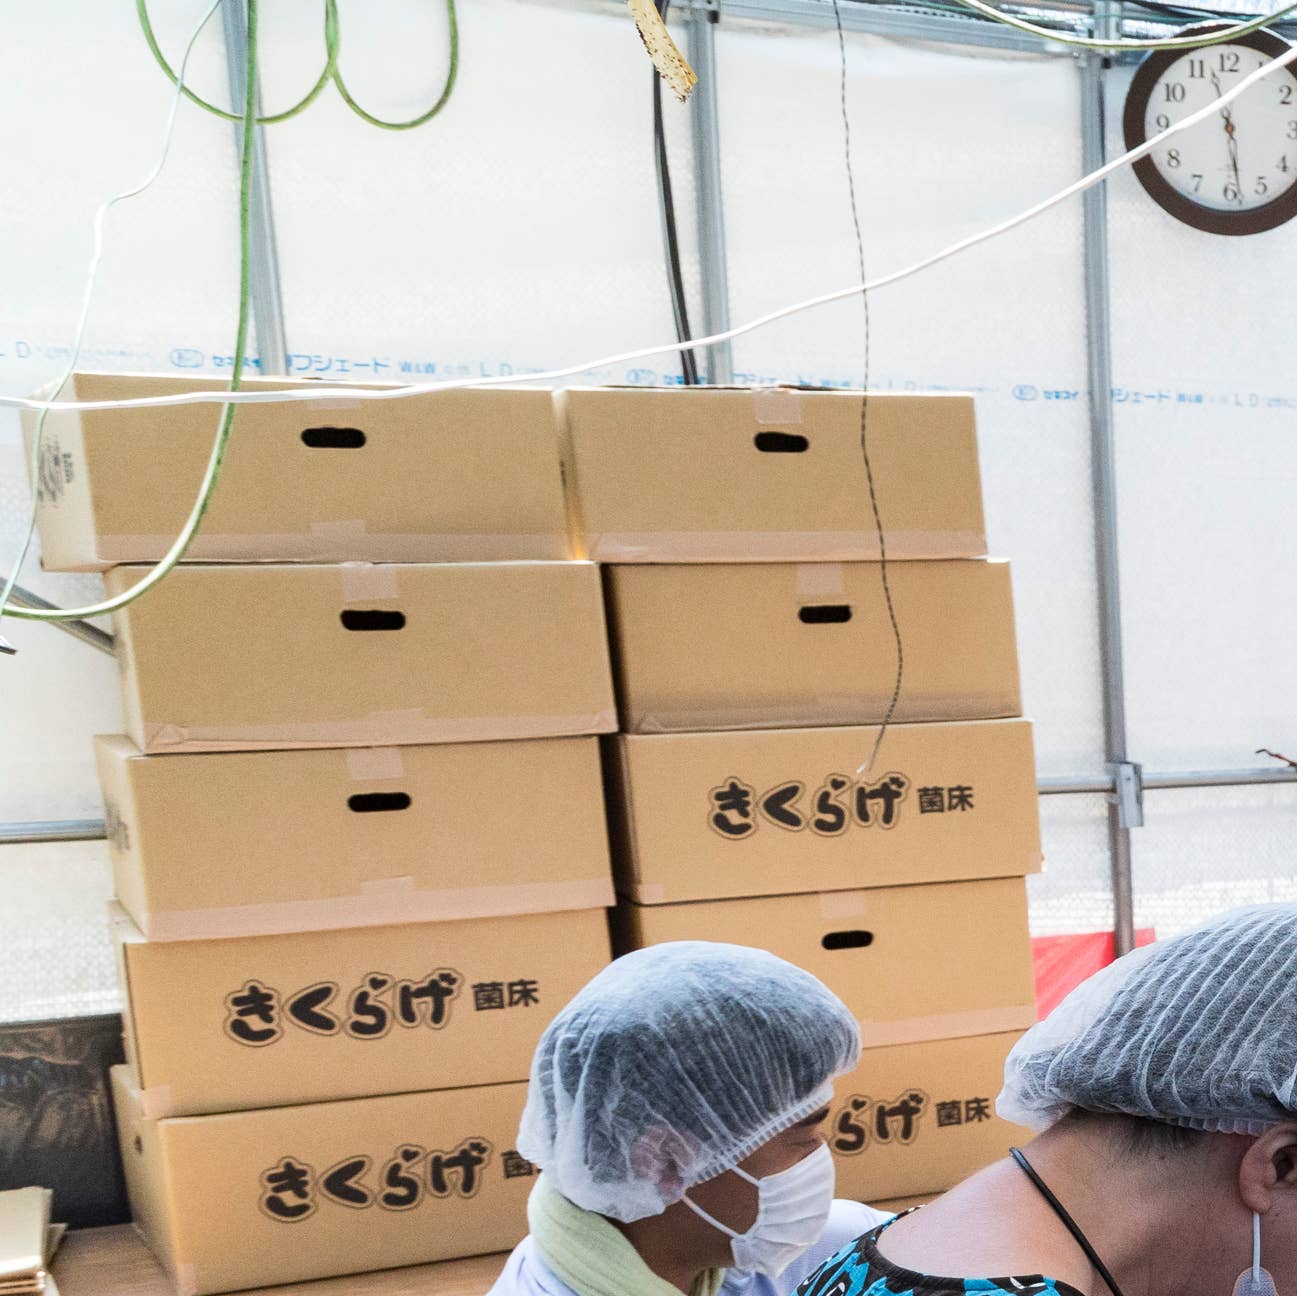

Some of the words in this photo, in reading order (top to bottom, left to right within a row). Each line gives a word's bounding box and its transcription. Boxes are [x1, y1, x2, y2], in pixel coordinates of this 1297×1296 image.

[1189, 59, 1205, 78] 11
[1219, 52, 1240, 73] 12
[1164, 83, 1185, 102] 10
[1279, 84, 1292, 105] 2
[1167, 149, 1181, 168] 8
[1276, 155, 1289, 173] 4
[1192, 175, 1203, 192] 7
[1223, 182, 1237, 201] 6
[1254, 176, 1268, 195] 5
[707, 771, 911, 841] きくらげ
[917, 785, 975, 815] 菌床
[223, 967, 465, 1047] きくらげ
[471, 978, 540, 1012] 菌床
[829, 1088, 930, 1157] らげ
[936, 1097, 991, 1128] 菌床
[259, 1136, 494, 1223] きくらげ
[500, 1150, 543, 1179] 菌
